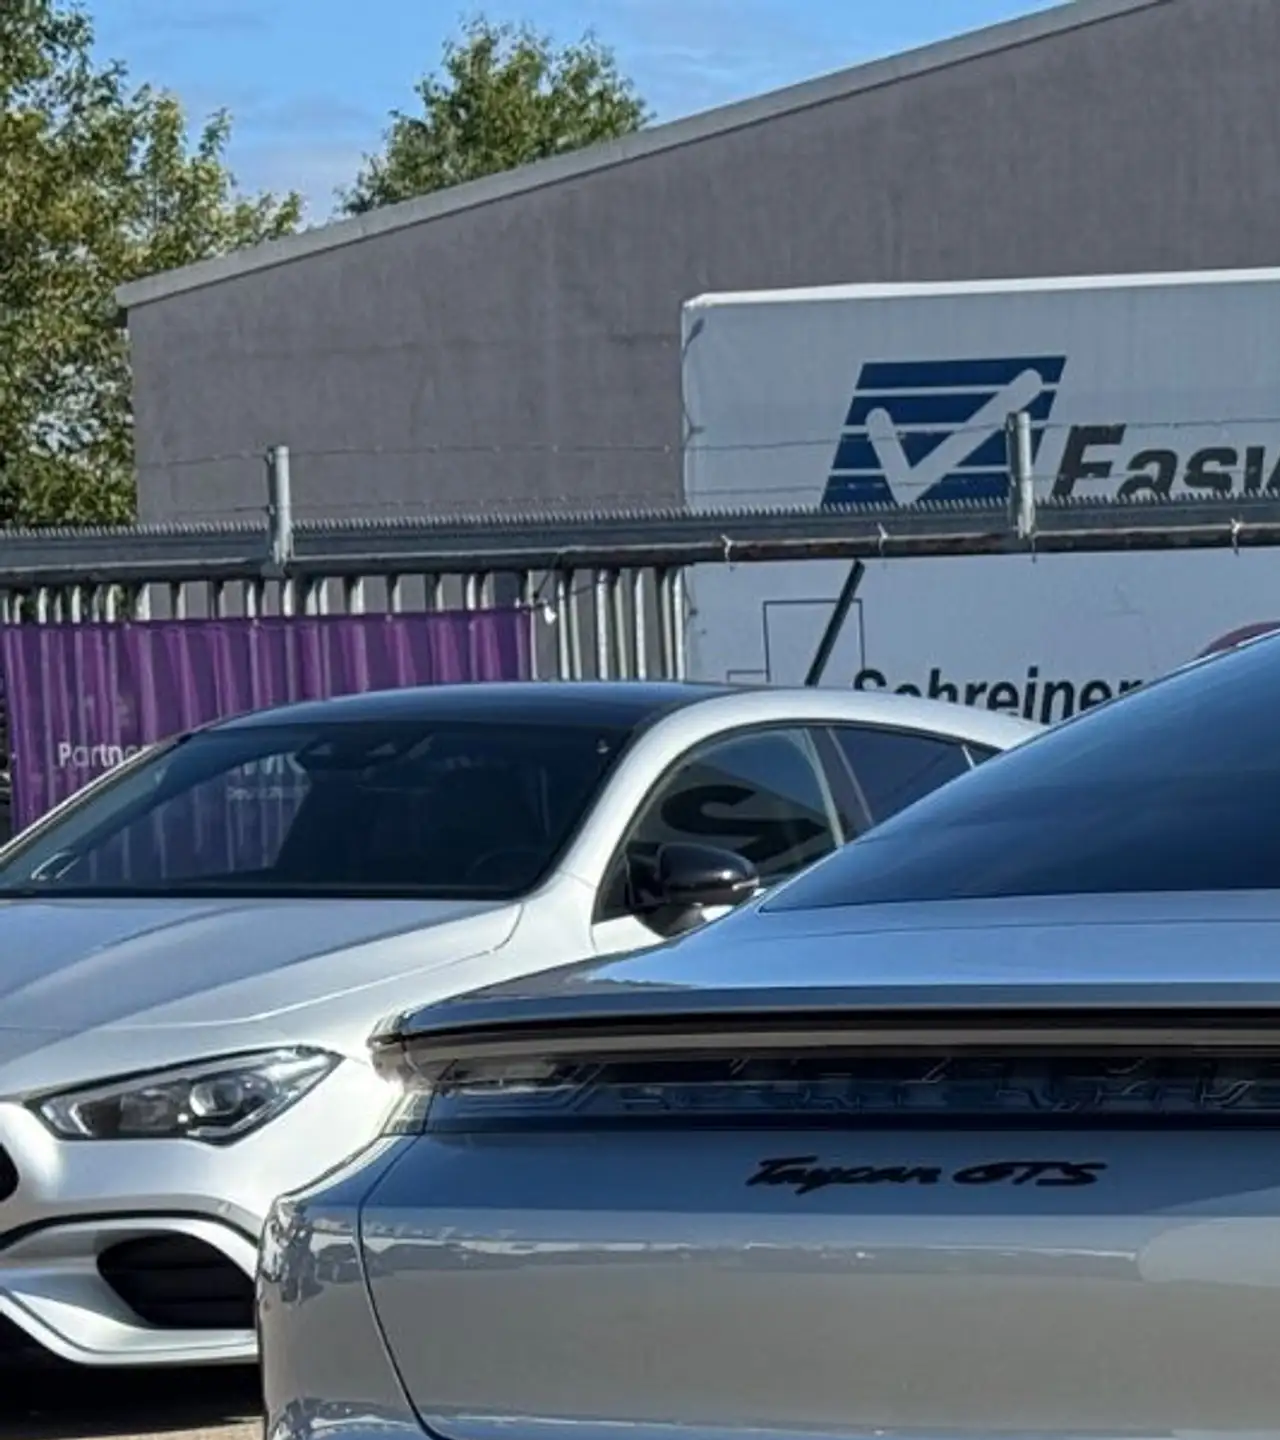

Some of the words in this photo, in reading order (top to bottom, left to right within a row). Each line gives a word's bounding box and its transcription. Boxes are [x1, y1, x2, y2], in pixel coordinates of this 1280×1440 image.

[853, 665, 1143, 726] hreine
[58, 741, 152, 768] Partn
[745, 1155, 942, 1196] Taycan
[952, 1160, 1108, 1187] GTS
